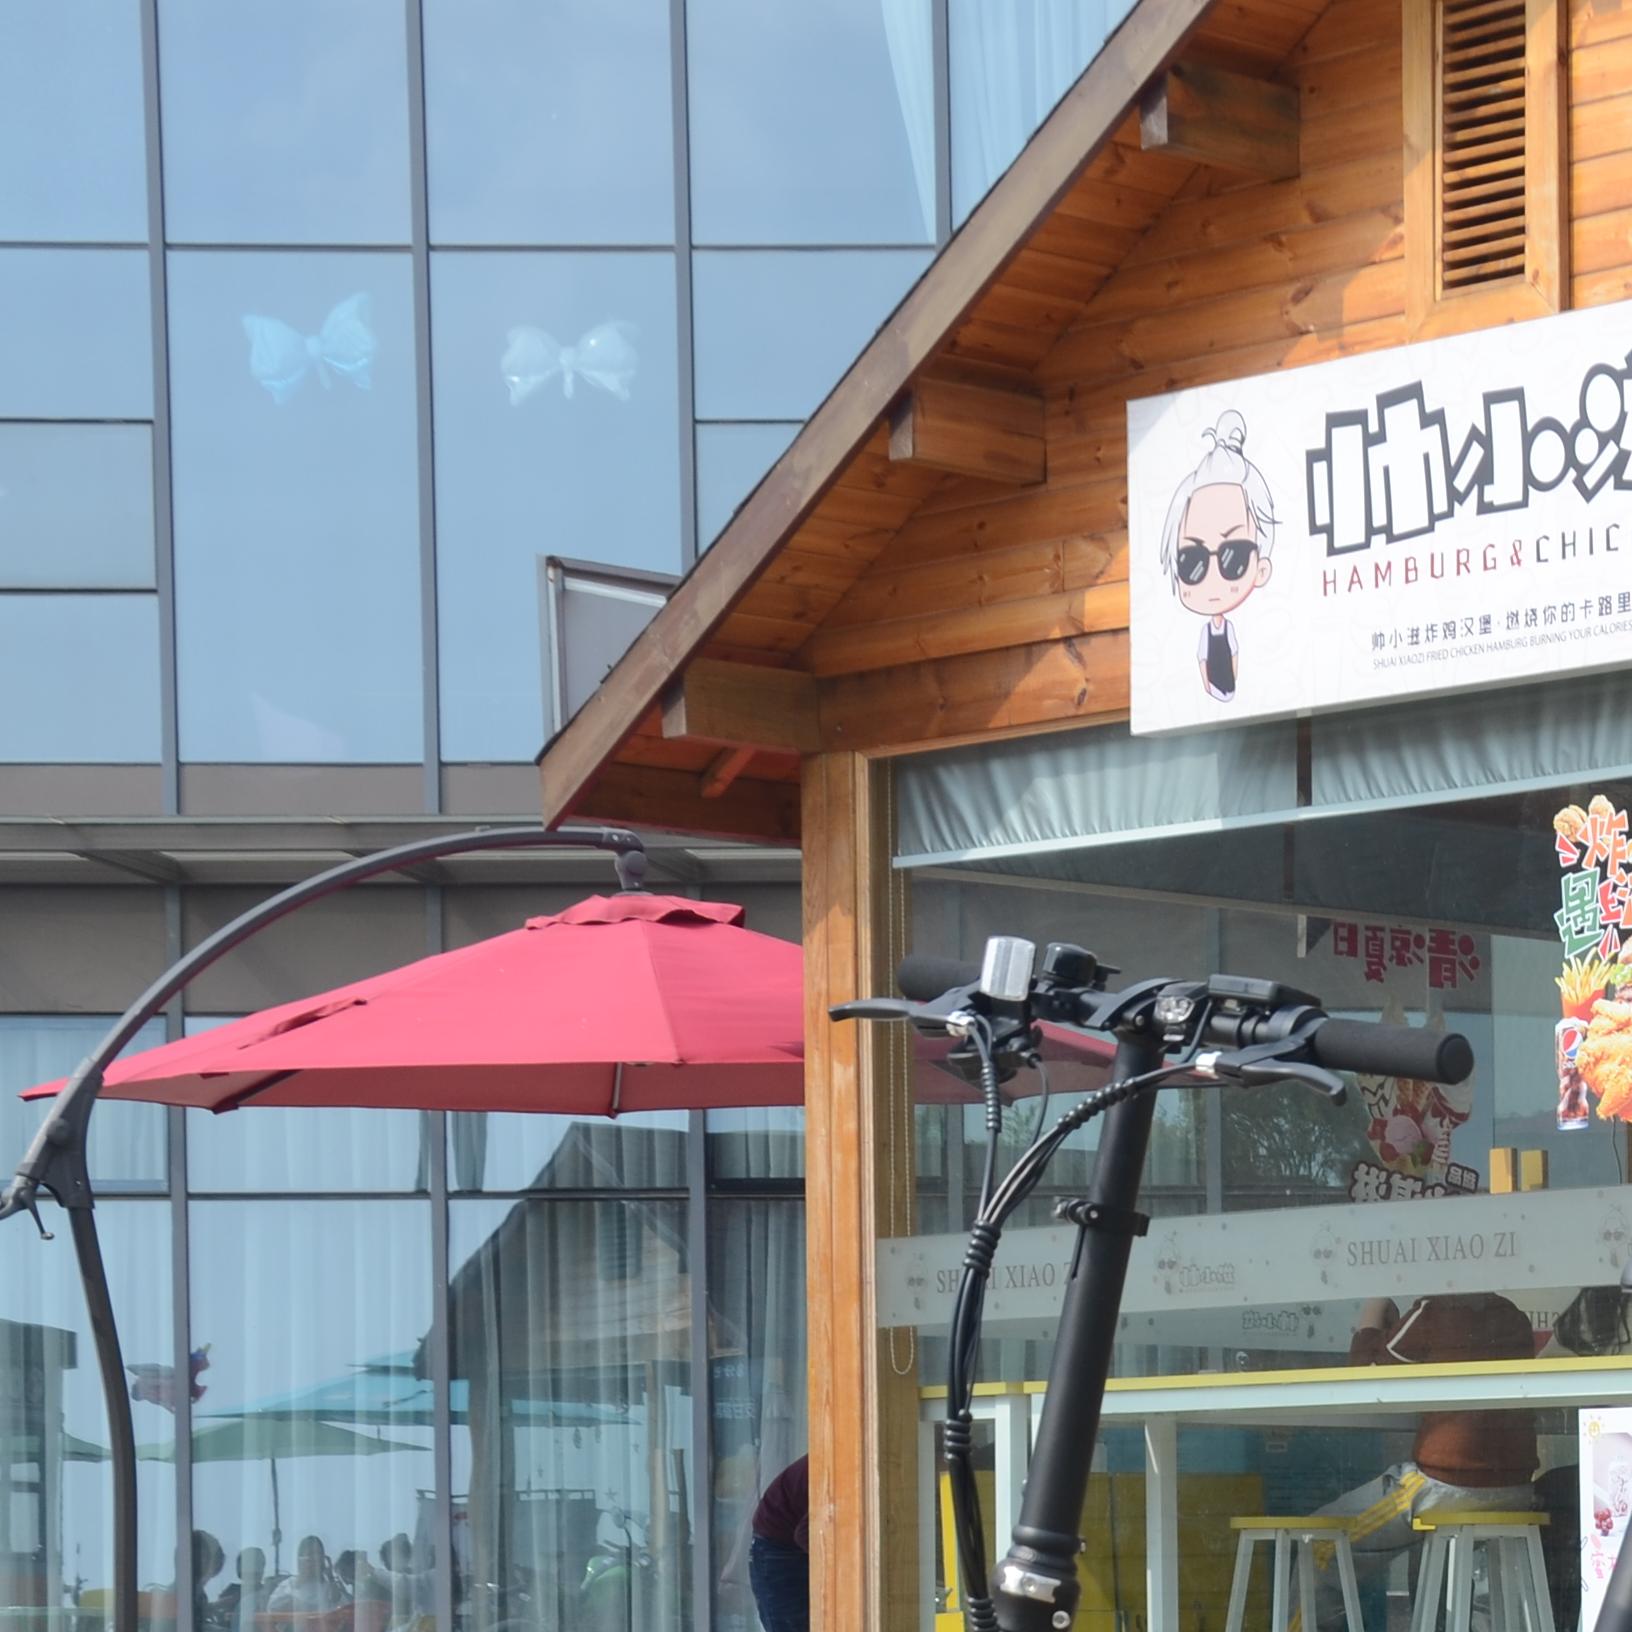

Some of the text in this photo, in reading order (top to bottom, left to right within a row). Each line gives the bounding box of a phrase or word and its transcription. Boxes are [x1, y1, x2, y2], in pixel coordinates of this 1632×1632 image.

[1373, 656, 1397, 670] SHUAI
[1426, 648, 1449, 662] FRIED
[1450, 643, 1485, 659] CHICKEN
[1486, 637, 1528, 654] HAMBURG
[1529, 631, 1567, 647] BURNING
[1568, 625, 1592, 641] YOUR
[1347, 1231, 1516, 1266] SHUAI XIAO ZI
[936, 1266, 998, 1294] SHI
[1005, 1262, 1056, 1289] XIAO
